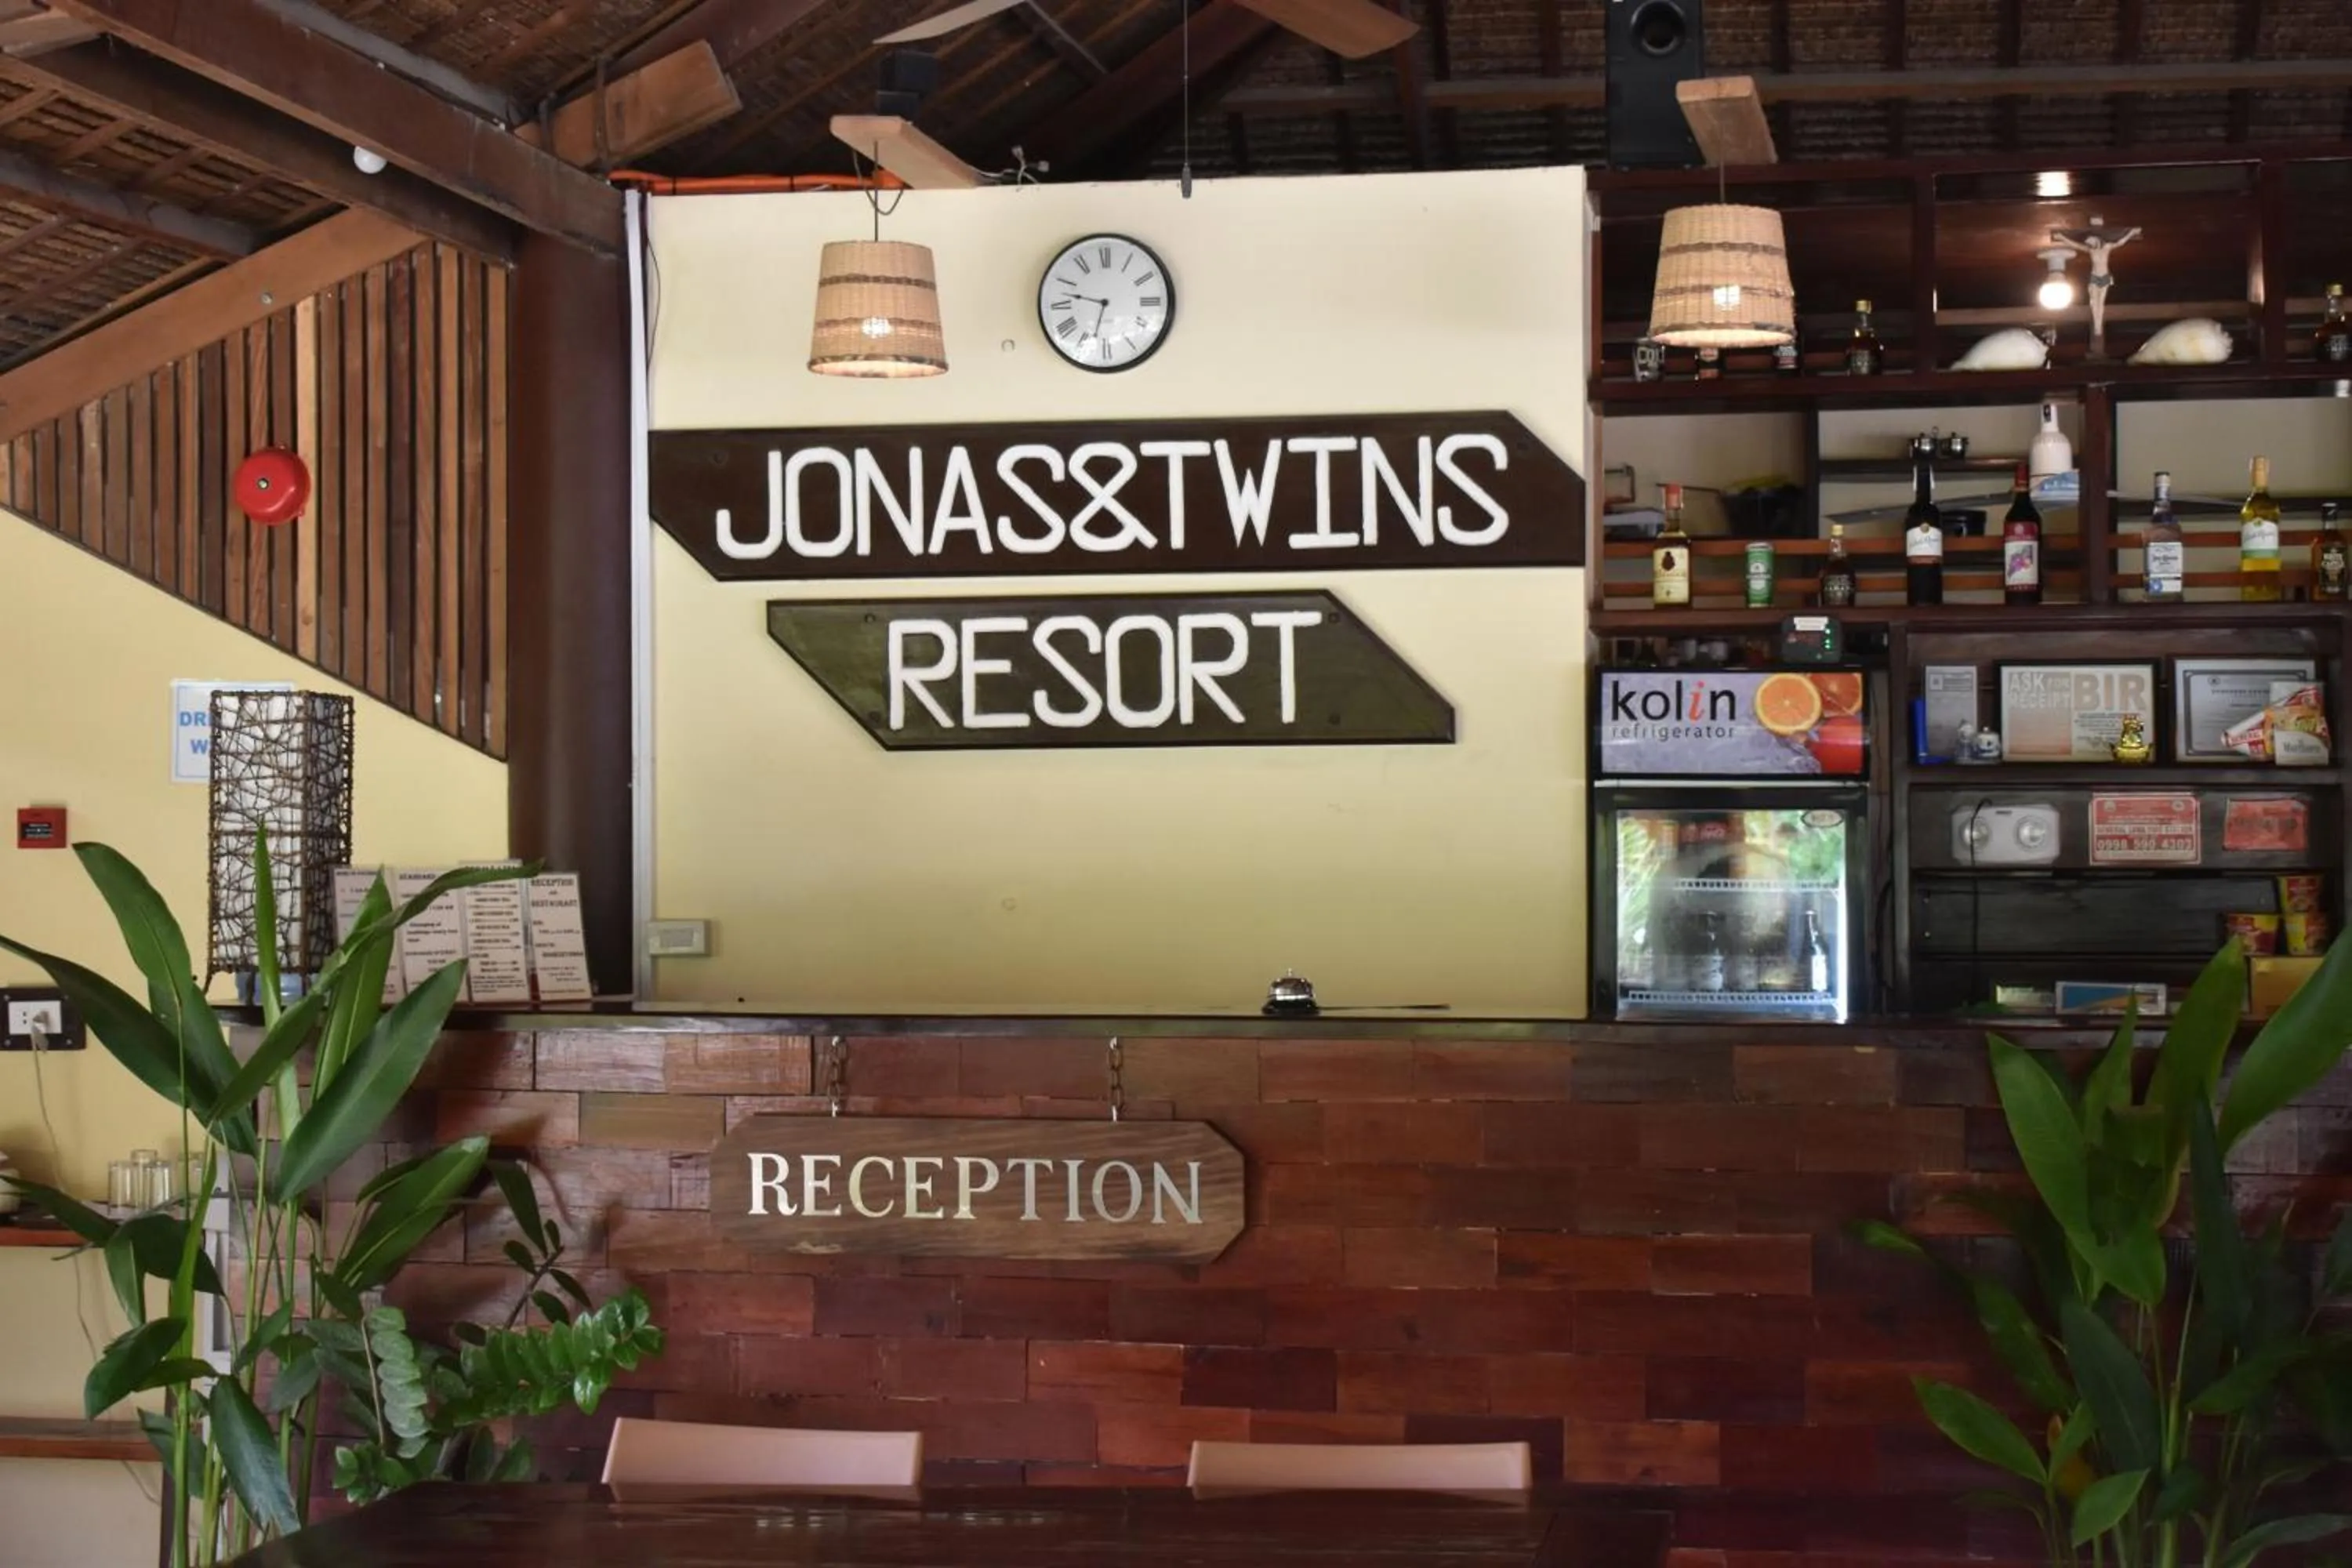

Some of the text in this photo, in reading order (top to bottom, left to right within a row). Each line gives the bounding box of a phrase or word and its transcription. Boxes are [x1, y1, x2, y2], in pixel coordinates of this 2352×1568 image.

[888, 611, 1323, 731] RESORT
[2009, 672, 2045, 691] ASK
[1611, 680, 1737, 722] kolin
[2009, 691, 2071, 709] RECEIPT
[2074, 673, 2147, 711] BIR
[1612, 724, 1737, 742] refrigerator
[746, 1152, 1203, 1225] RECEPTION
